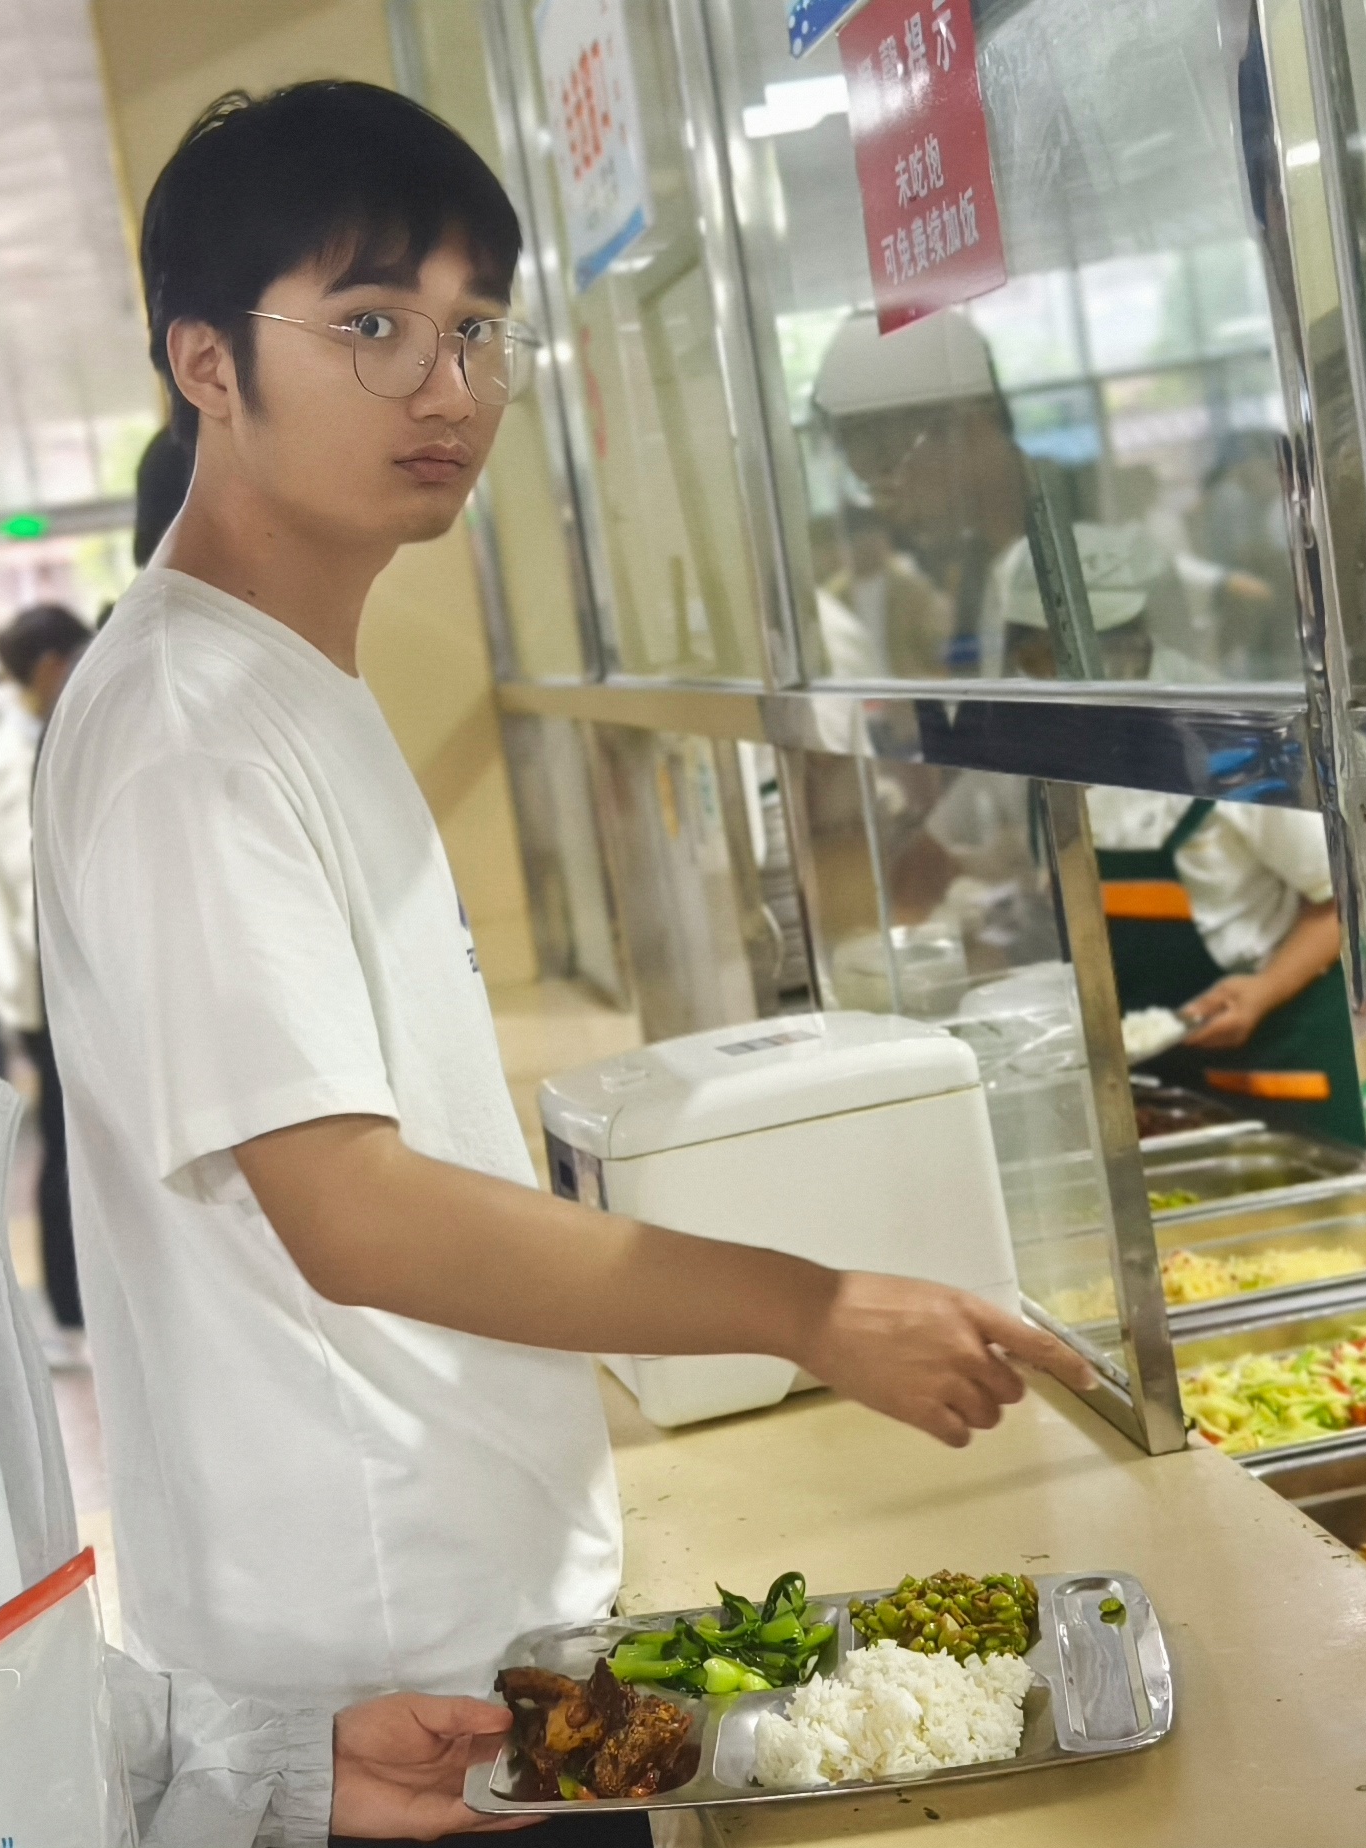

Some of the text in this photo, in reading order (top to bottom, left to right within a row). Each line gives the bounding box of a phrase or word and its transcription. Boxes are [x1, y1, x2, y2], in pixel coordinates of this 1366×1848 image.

[894, 132, 945, 210] 未吃饱
[880, 185, 980, 286] 可免费续加饭
